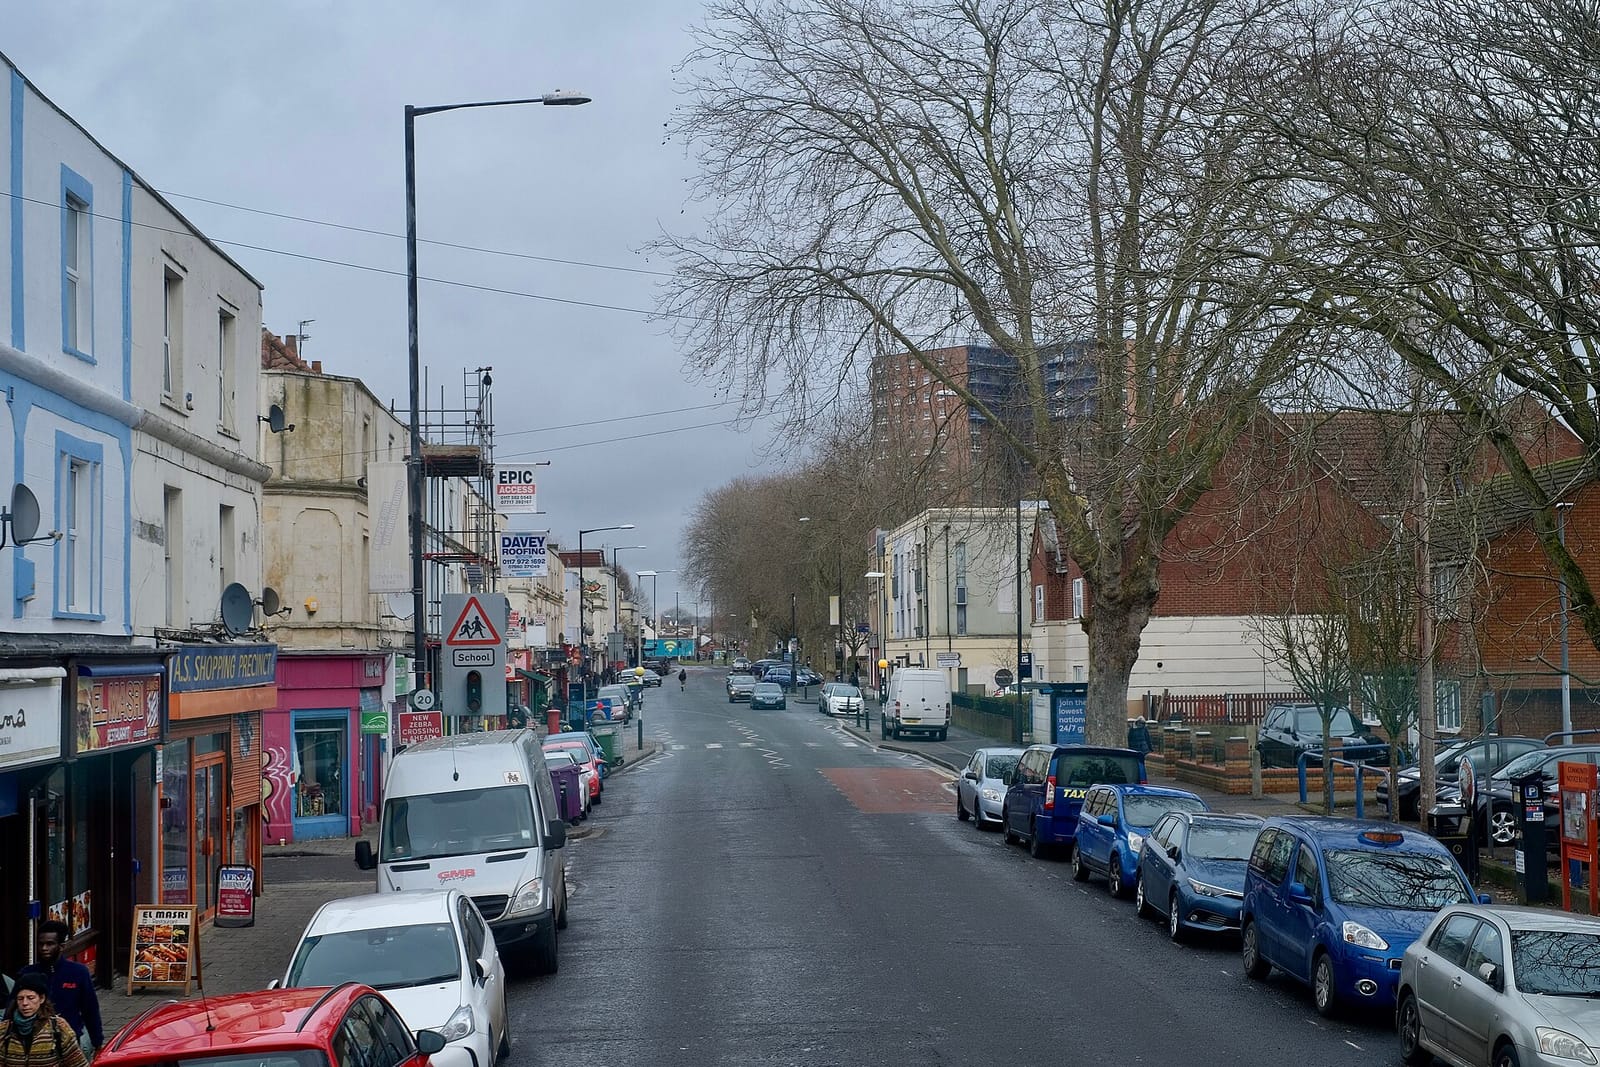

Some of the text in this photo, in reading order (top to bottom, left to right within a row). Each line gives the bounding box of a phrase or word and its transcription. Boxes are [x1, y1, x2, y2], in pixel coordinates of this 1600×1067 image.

[499, 470, 533, 484] EPIC
[499, 486, 534, 494] ACCESS
[502, 536, 546, 547] DAVEY
[502, 547, 546, 555] ROOFING
[458, 653, 490, 662] School
[173, 653, 272, 682] A.S. SHOPPING PRECINCT
[92, 680, 144, 726] EL MASRI
[417, 695, 432, 704] 20
[402, 727, 440, 735] CROSSING
[410, 734, 434, 742] AHEAD
[1063, 789, 1087, 799] TAX
[437, 868, 475, 879] GMB
[155, 911, 188, 919] MASRI
